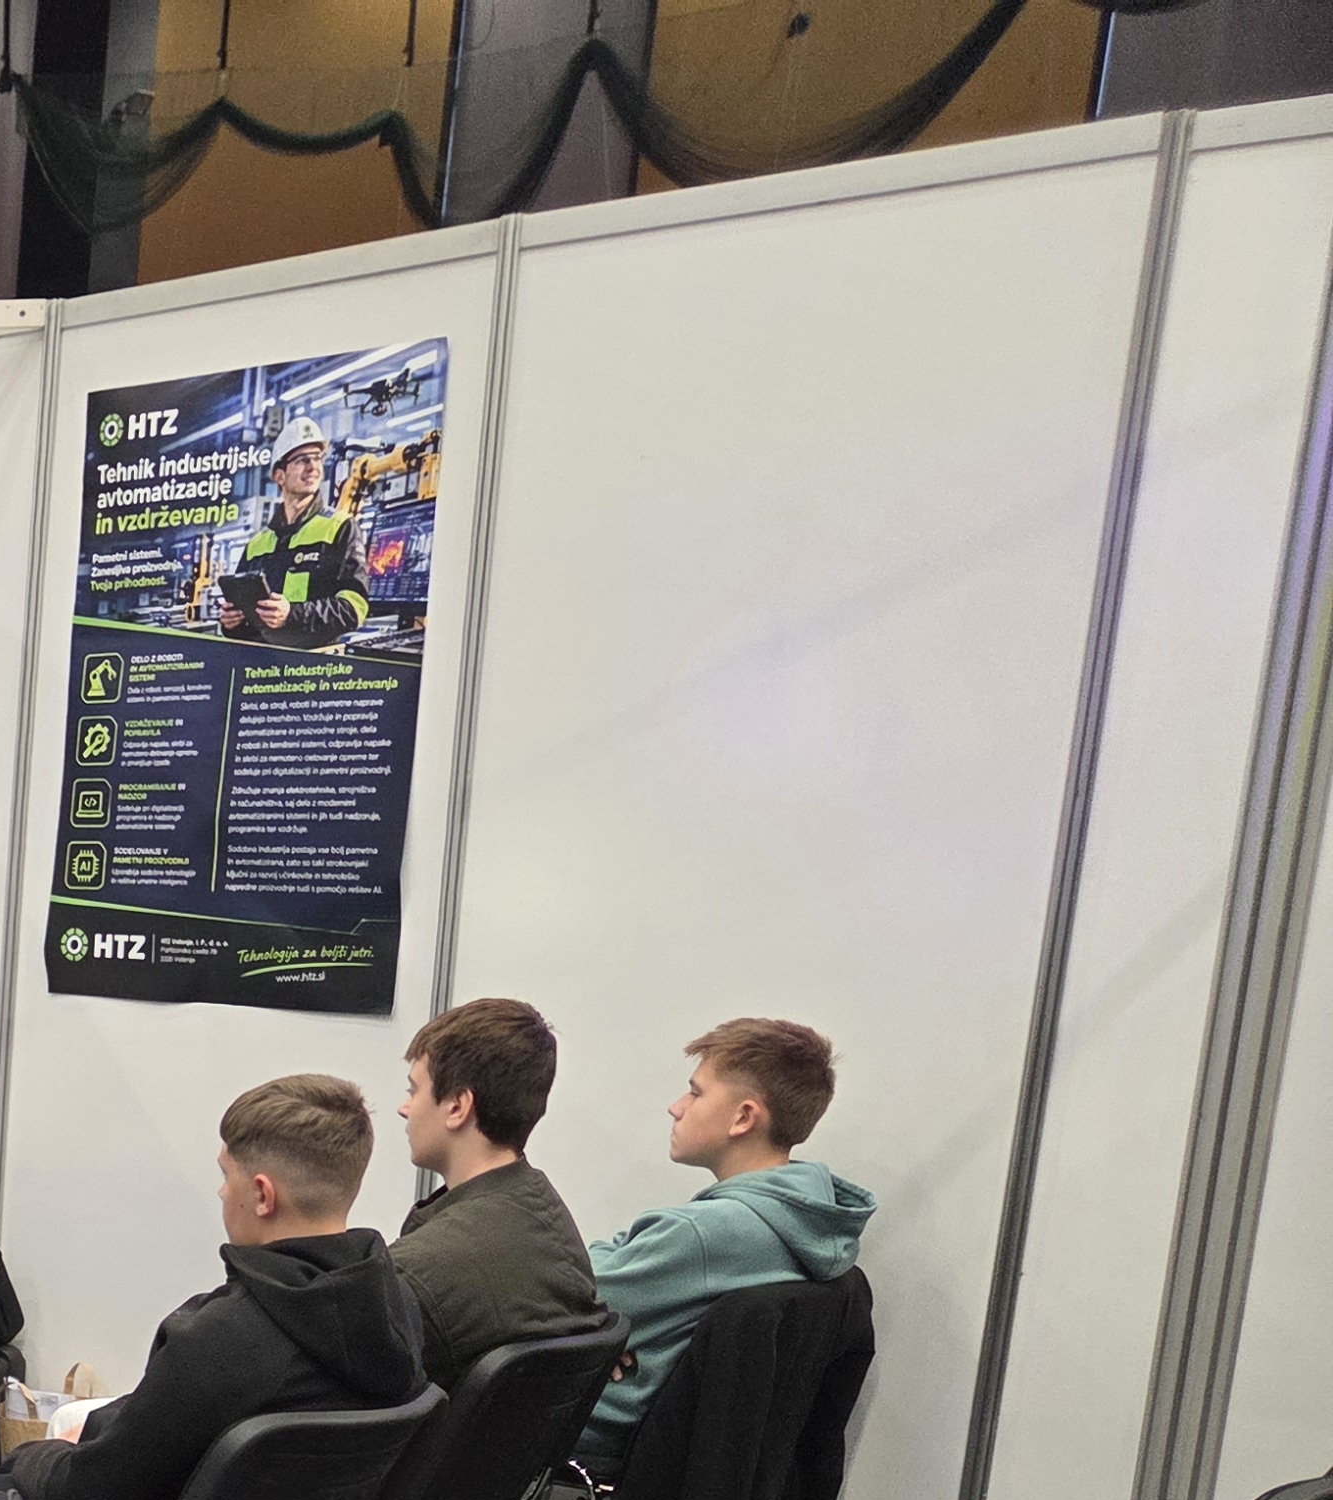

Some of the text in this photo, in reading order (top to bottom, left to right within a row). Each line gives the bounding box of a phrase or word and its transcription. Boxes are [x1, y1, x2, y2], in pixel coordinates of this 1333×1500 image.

[127, 408, 179, 440] HTZ
[97, 445, 271, 485] Tehnik industrijske
[97, 473, 232, 509] avtomatizacije
[95, 498, 239, 535] in vzdrževanja
[90, 575, 168, 592] Tvoja prihodnost.
[244, 663, 353, 679] Tehnik industrijske
[242, 676, 399, 694] avtomatizacije in vzdrževanja
[80, 861, 91, 871] AI
[93, 933, 146, 960] HTZ
[237, 945, 374, 964] Tehnologija za boljši jutri.
[275, 971, 325, 982] www.htz.si
